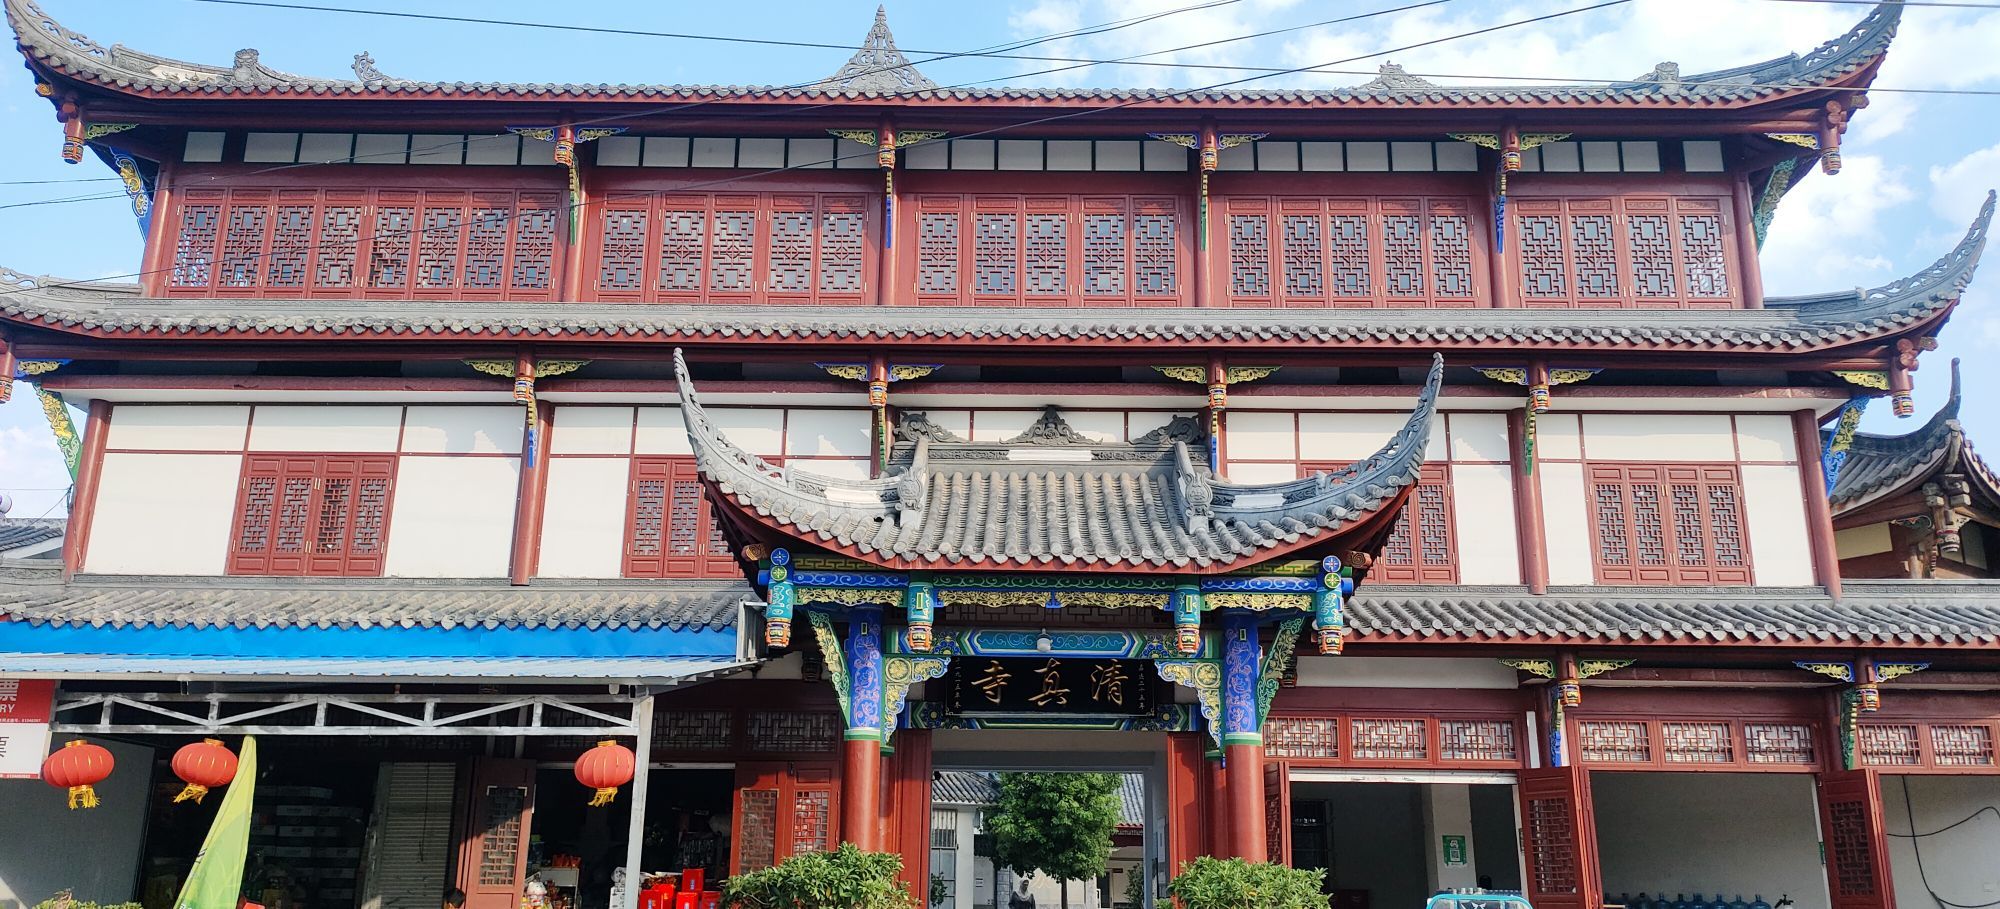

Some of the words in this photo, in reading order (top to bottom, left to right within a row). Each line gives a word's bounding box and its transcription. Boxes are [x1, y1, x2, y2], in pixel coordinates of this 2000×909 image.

[0, 680, 19, 701] 票
[970, 657, 1129, 706] 清真寺
